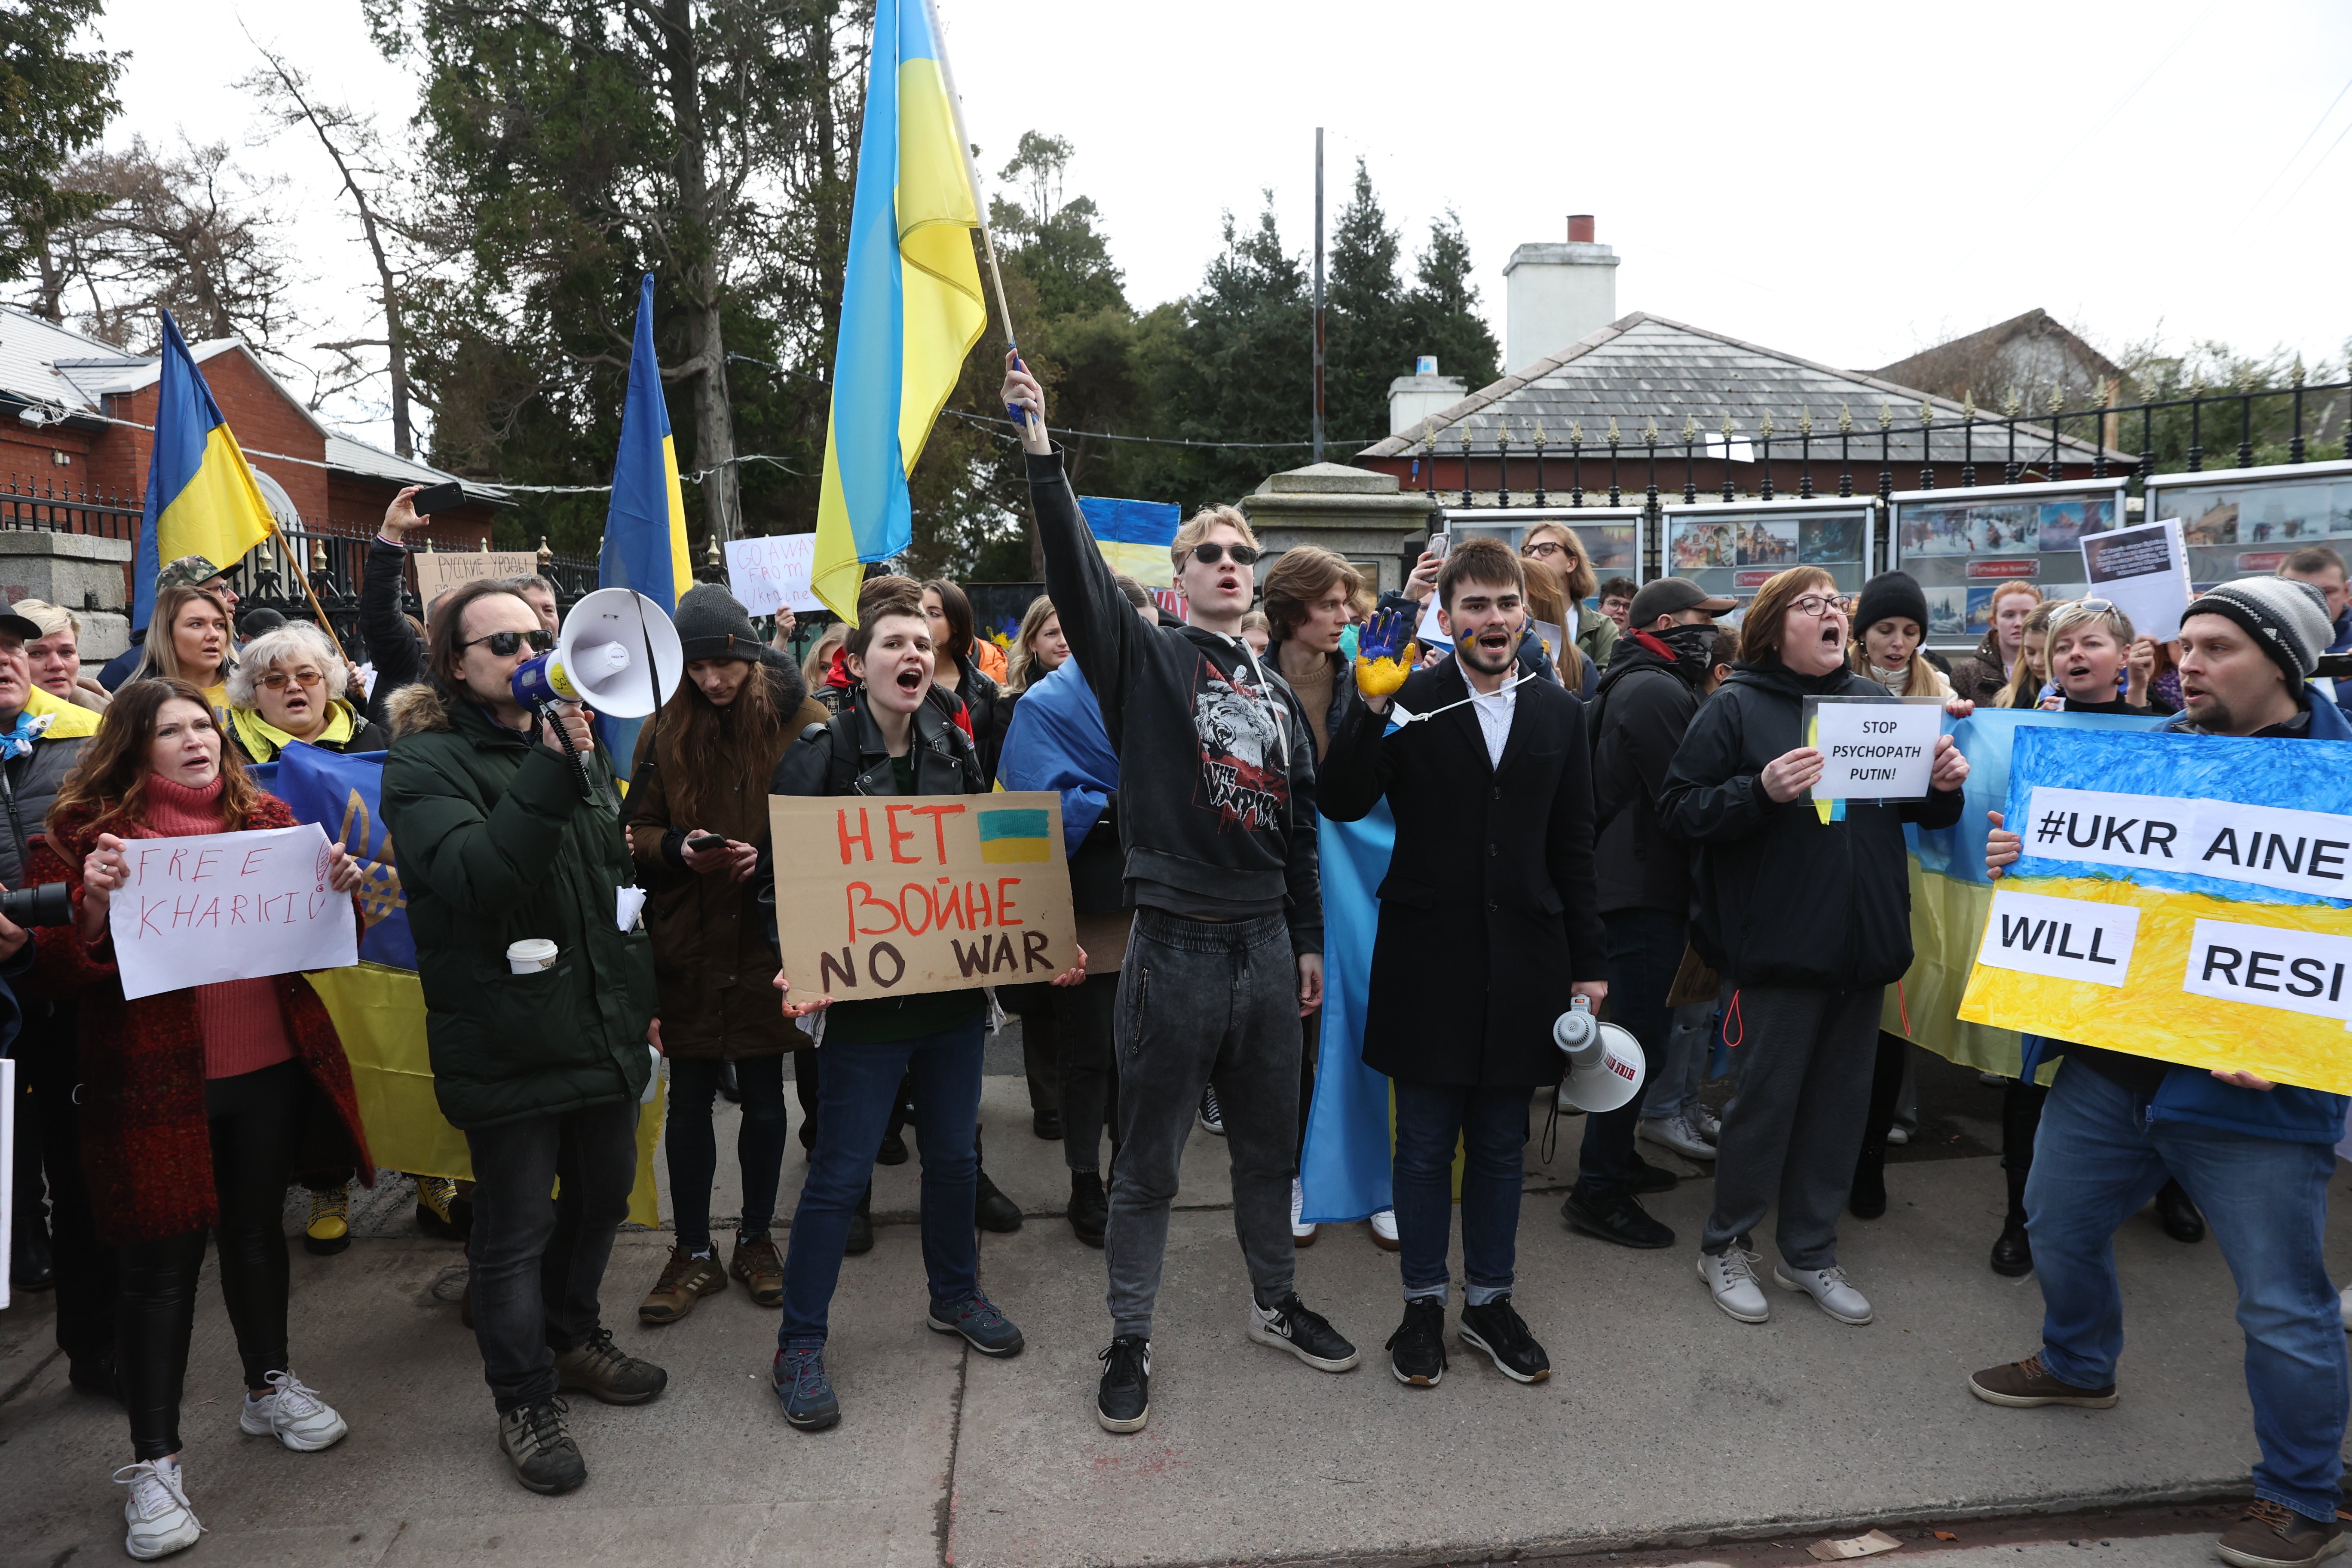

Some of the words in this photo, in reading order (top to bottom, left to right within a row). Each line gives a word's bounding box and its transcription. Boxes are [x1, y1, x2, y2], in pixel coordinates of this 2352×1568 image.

[438, 555, 484, 582] РУССКИЕ
[737, 544, 762, 570] GO
[768, 538, 816, 564] AWAY
[748, 562, 803, 583] FROM
[744, 587, 810, 609] Ukraine
[1863, 721, 1898, 734] STOP
[1832, 745, 1921, 758] PSYCHOPATH
[1850, 768, 1896, 781] PUTIN!
[837, 804, 968, 866] НЕТ
[2037, 810, 2178, 858] #UKR
[2202, 827, 2350, 881] AINE
[846, 877, 1025, 945] ВОЙНЕ
[820, 940, 906, 994] NO
[950, 930, 1054, 978] WAR
[2001, 914, 2116, 965] WILL
[2202, 944, 2345, 1002] RESI
